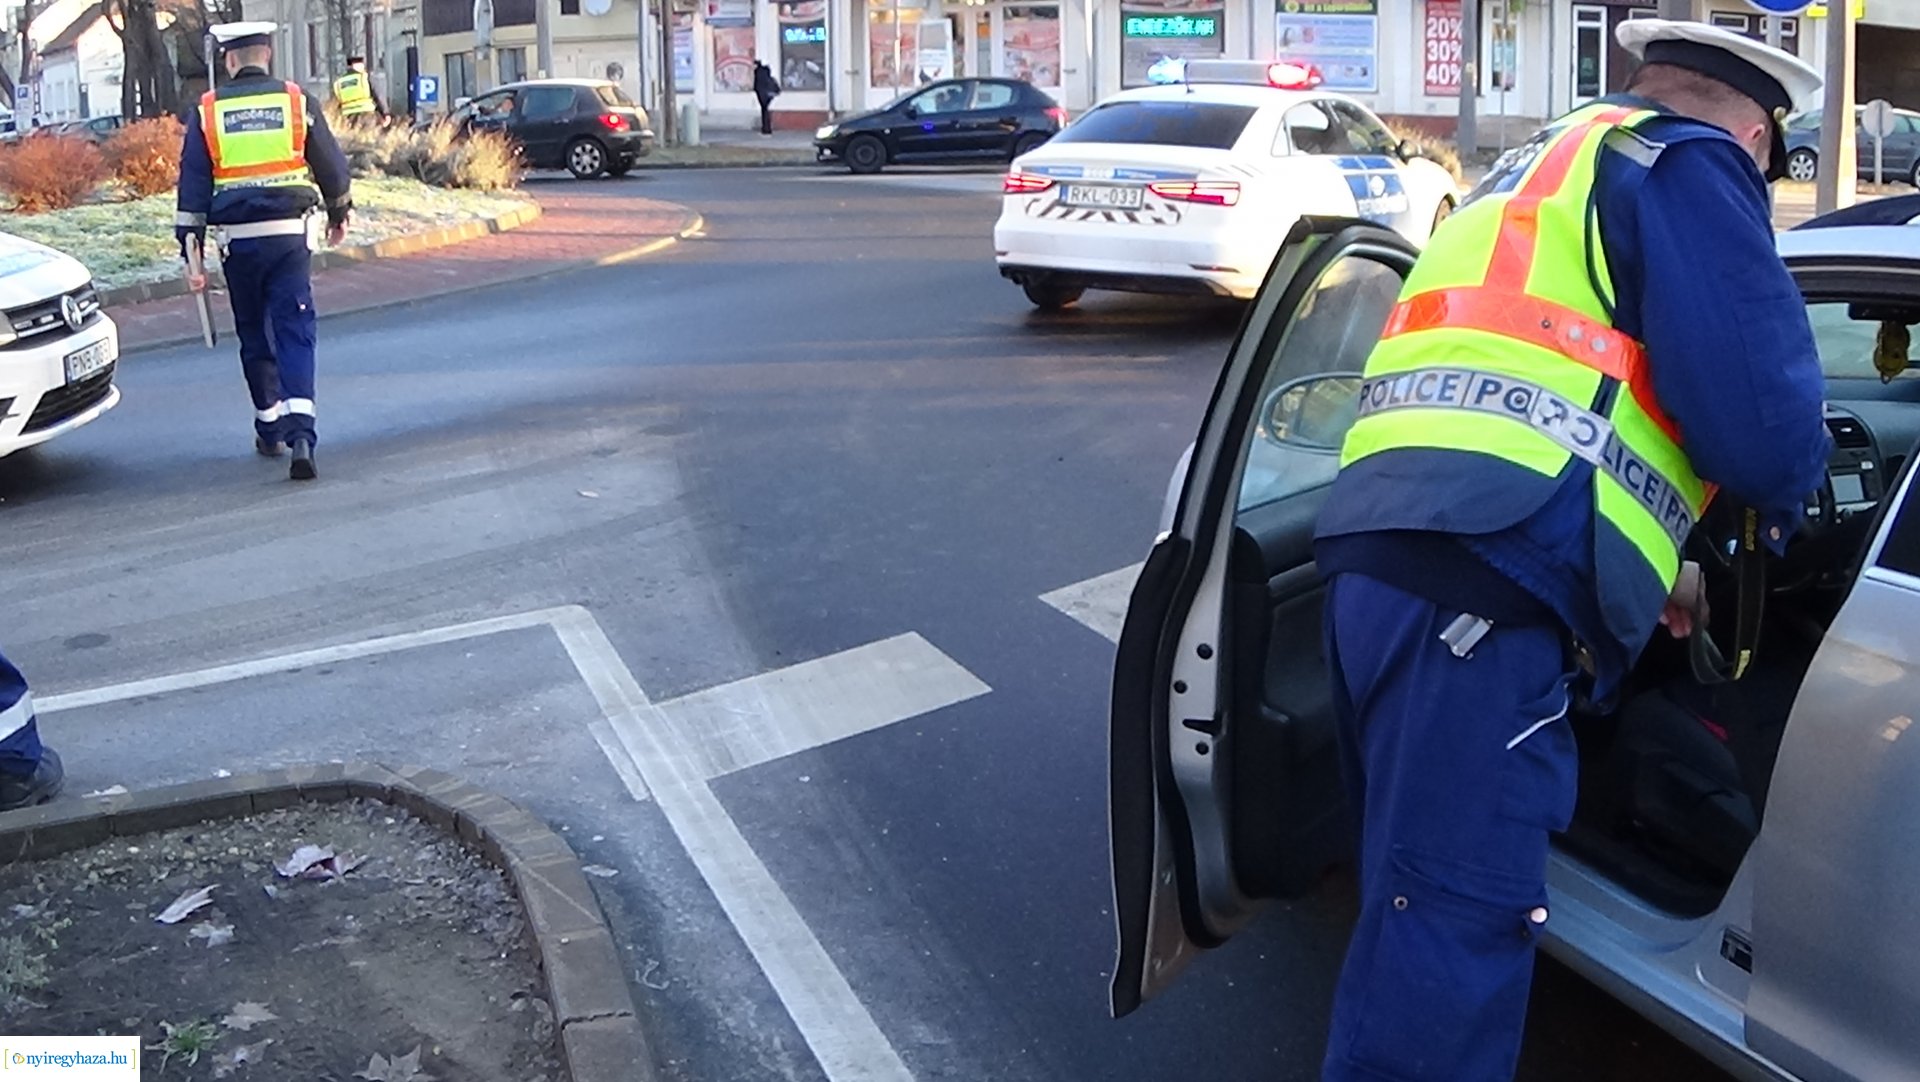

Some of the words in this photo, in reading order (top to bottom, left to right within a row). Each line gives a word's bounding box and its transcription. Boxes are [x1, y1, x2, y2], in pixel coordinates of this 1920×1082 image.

[1427, 17, 1462, 39] 20%
[1427, 40, 1462, 62] 30%
[1426, 63, 1461, 85] 40%
[420, 78, 436, 100] P
[1071, 187, 1138, 205] RKL-033
[1359, 373, 1461, 411] POLICE
